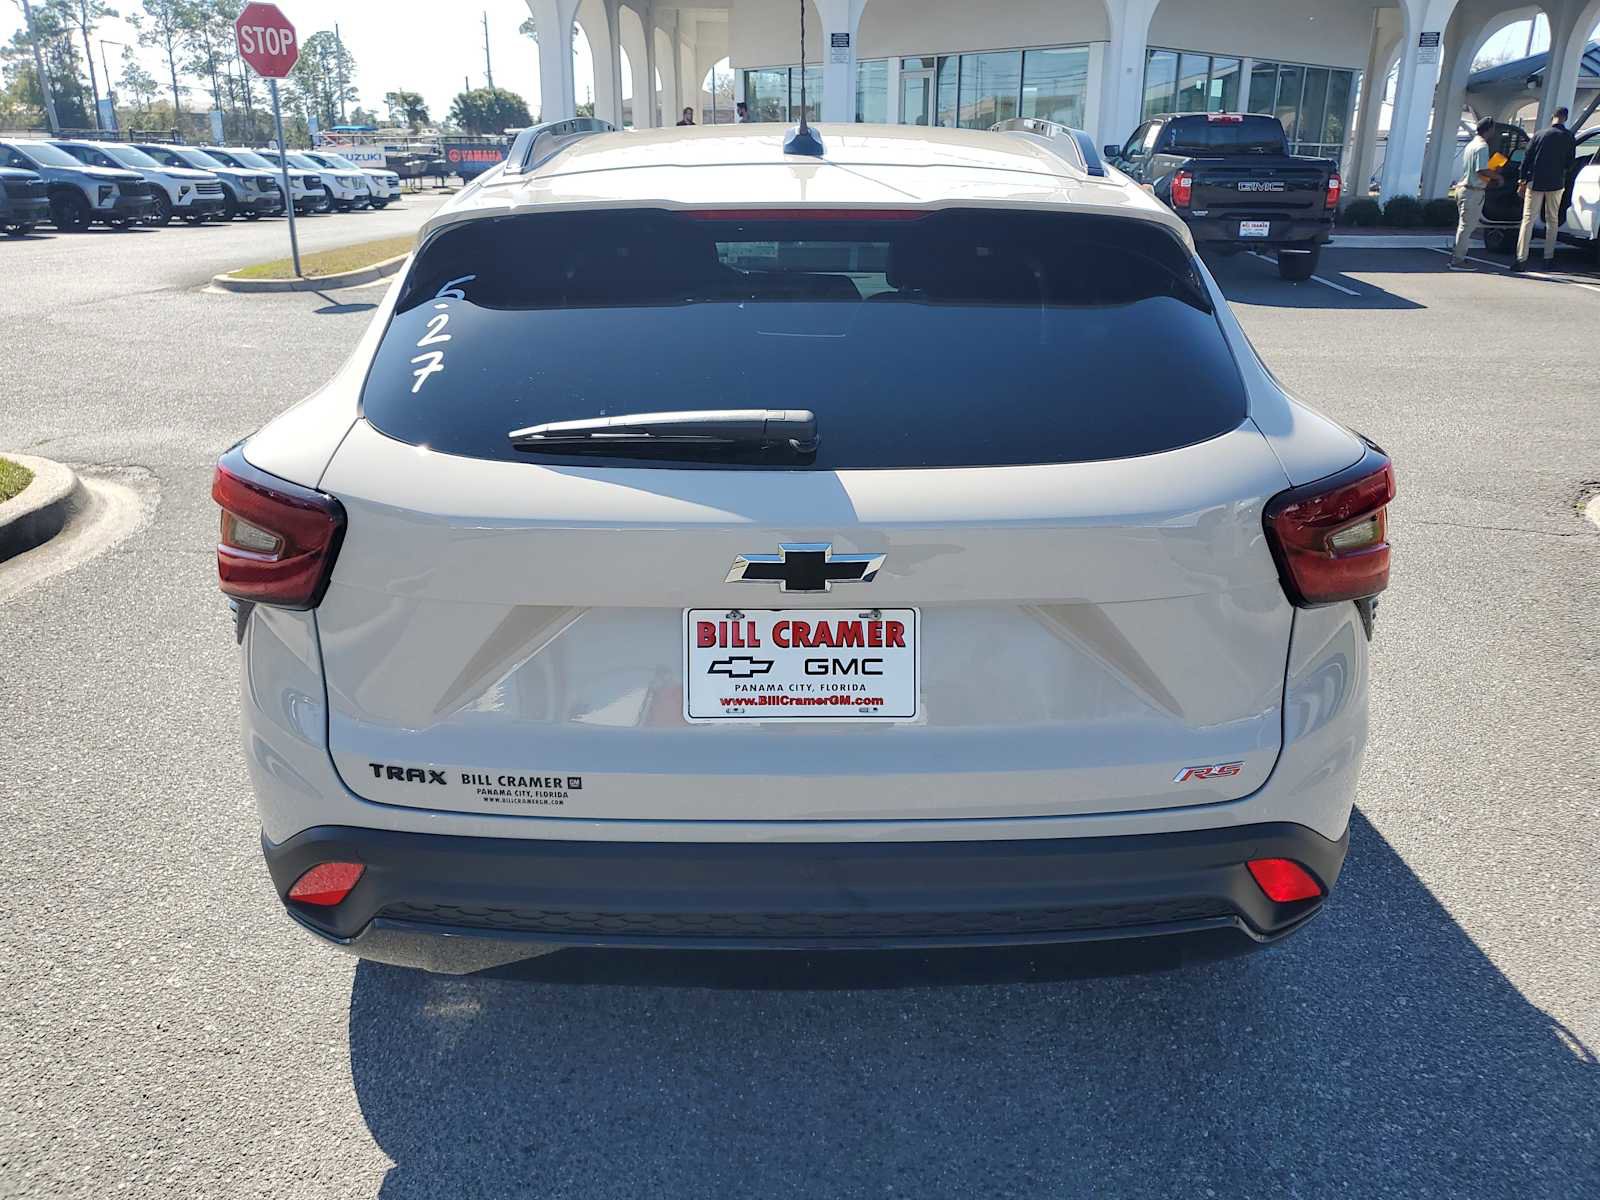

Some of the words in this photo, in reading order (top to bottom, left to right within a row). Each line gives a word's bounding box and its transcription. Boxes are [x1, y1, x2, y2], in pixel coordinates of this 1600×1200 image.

[241, 25, 294, 56] STOP
[1238, 182, 1285, 192] GMC
[697, 620, 761, 649] BILL
[771, 620, 906, 649] CRAMER
[804, 658, 884, 676] GMC
[735, 683, 784, 692] PANAMA
[789, 683, 815, 693] CITY,
[820, 683, 867, 692] FLORIDA
[720, 695, 884, 706] www.BillCramerGM.com
[369, 763, 447, 785] TRAX
[1174, 761, 1244, 783] RS
[461, 773, 493, 786] BILL
[498, 775, 563, 789] CRAMER
[477, 788, 512, 796] PANAMA
[514, 790, 533, 798] CITY,
[535, 790, 569, 799] FLORIDA
